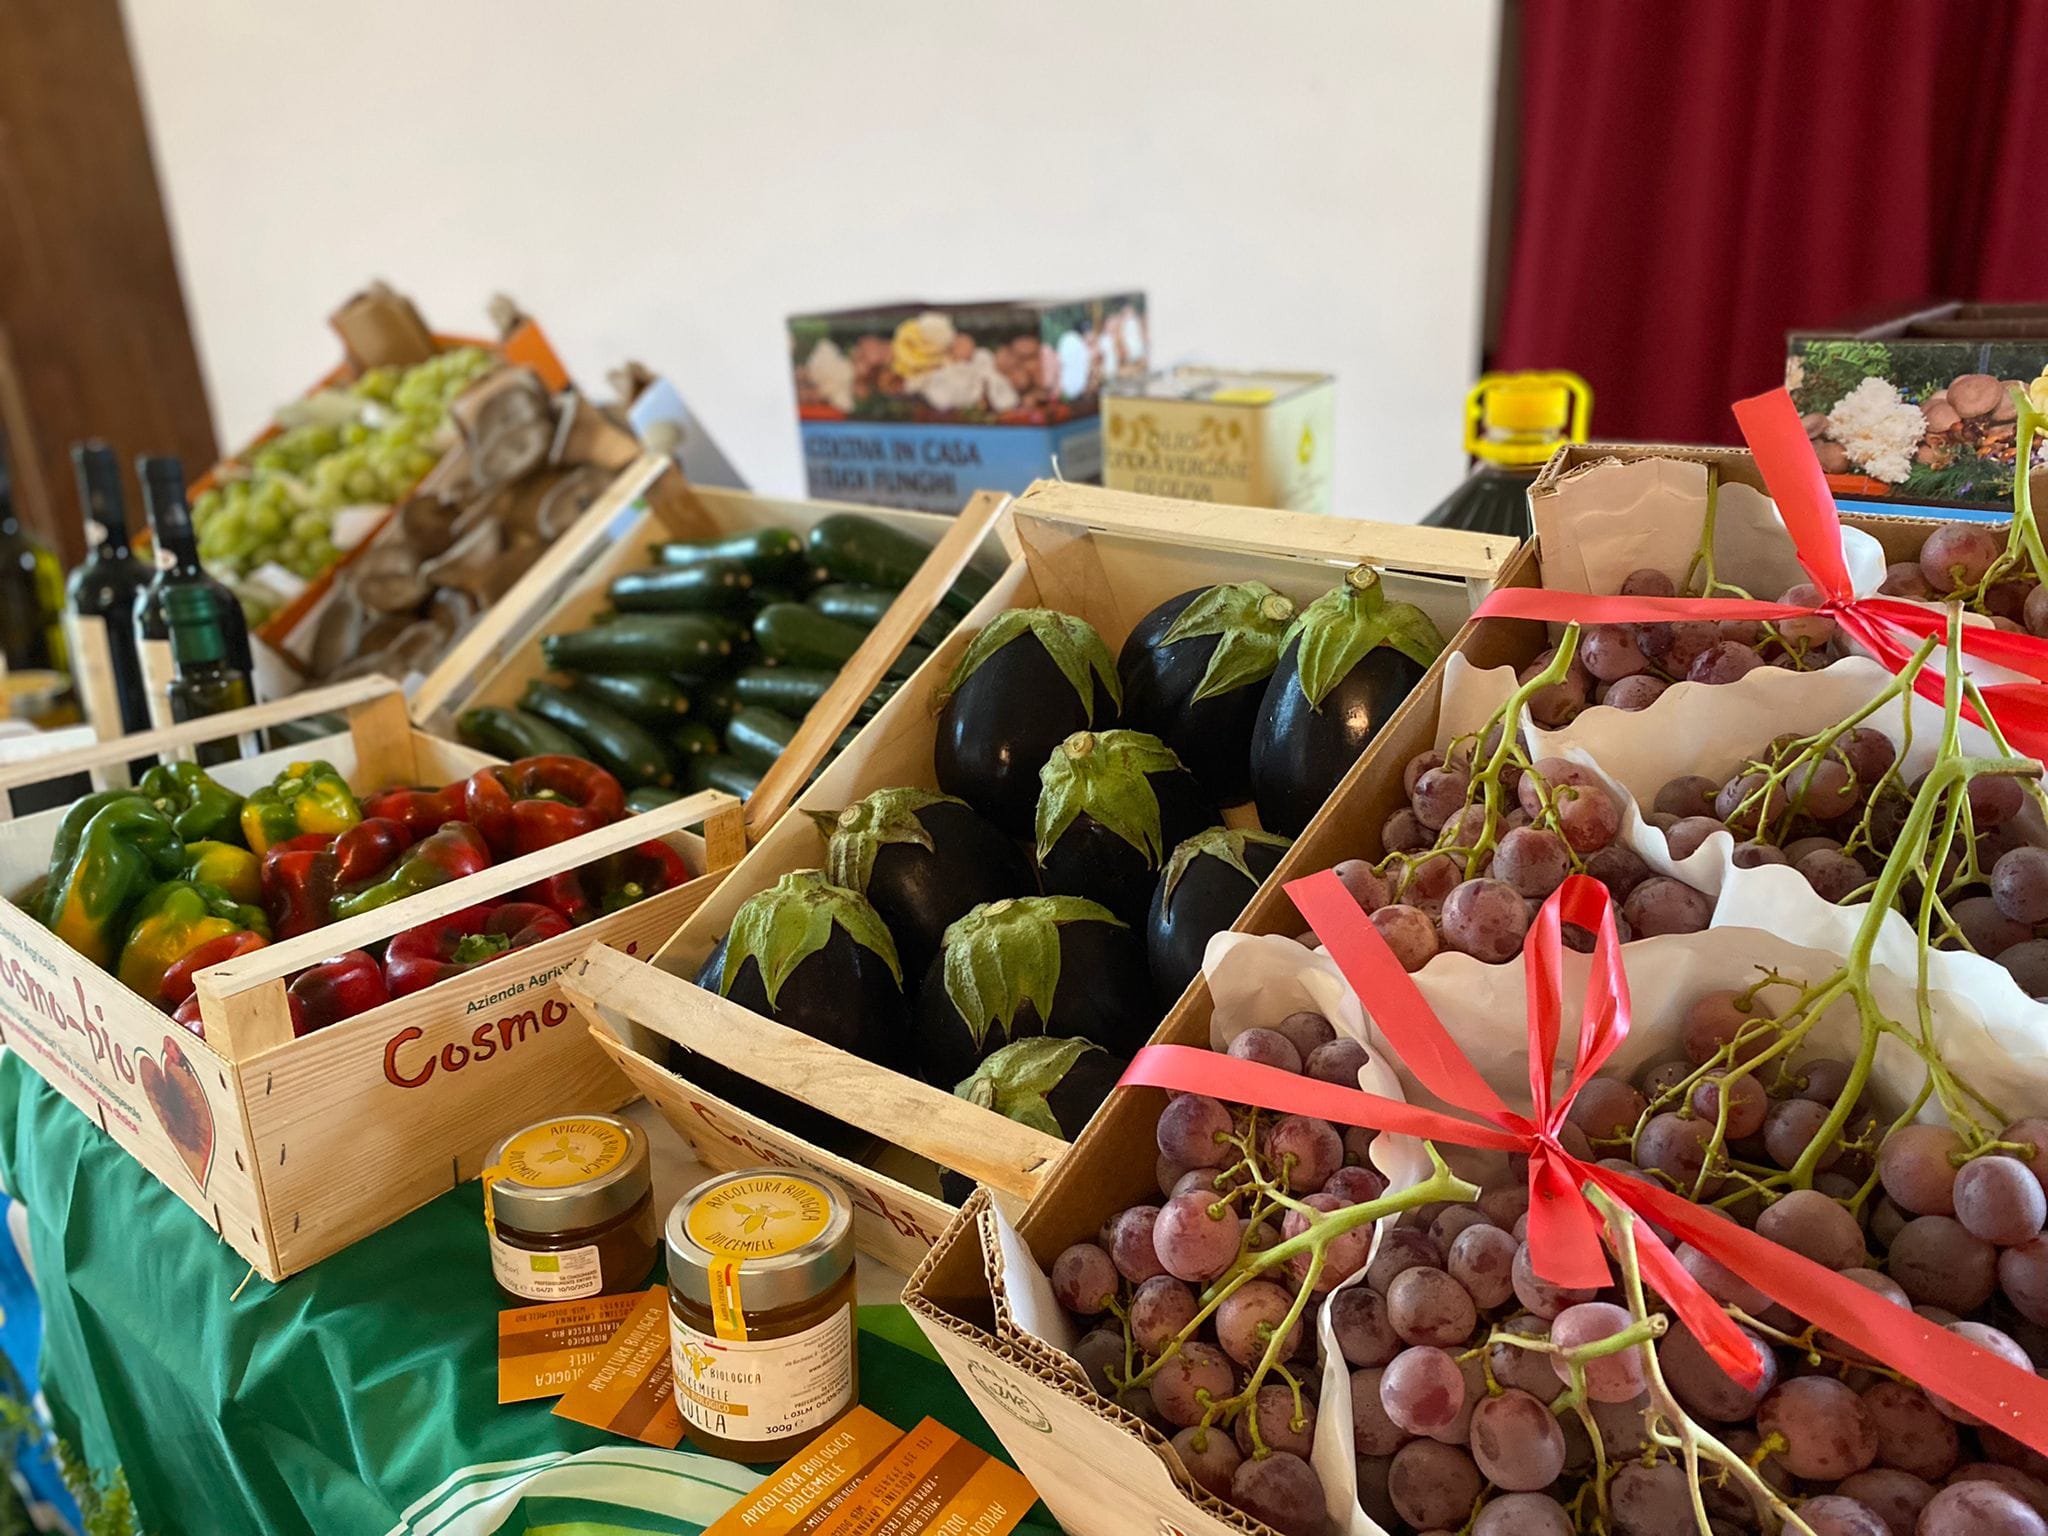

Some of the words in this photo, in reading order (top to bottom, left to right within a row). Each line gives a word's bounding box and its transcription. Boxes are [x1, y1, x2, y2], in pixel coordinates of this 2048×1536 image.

[891, 438, 916, 463] IN
[921, 437, 982, 467] CASA
[466, 983, 525, 1015] Azienda
[528, 958, 577, 988] Agric
[0, 953, 136, 1085] osmo-bio
[384, 998, 577, 1089] Cosmo
[550, 1123, 615, 1142] APICOLTURA
[507, 1149, 543, 1182] DOLCEMIELE
[705, 1181, 782, 1210] APICOLTURA
[782, 1184, 821, 1222] BIOLOGICA
[704, 1231, 776, 1252] DOLCEMIELE
[558, 1281, 594, 1293] 10/10/2023
[588, 1345, 634, 1393] APICOLTURA
[623, 1307, 664, 1348] BIOLOGICA
[622, 1333, 666, 1378] DOLCEMIELE
[709, 1368, 761, 1385] BIOLOGICA
[680, 1392, 727, 1434] SULLA
[765, 1423, 793, 1436] 300g
[903, 1453, 918, 1468] 339
[741, 1471, 807, 1527] APICOLTURA
[800, 1431, 856, 1476] BIOLOGICA
[783, 1462, 846, 1515] DOLCEMIELE
[880, 1471, 917, 1507] AGOSTINO
[913, 1479, 938, 1501] PAPPA
[806, 1505, 832, 1528] MIELE
[851, 1506, 885, 1536] LAMANN
[895, 1498, 919, 1519] REALE
[922, 1498, 942, 1521] MIELE
[968, 1501, 1008, 1536] APICOL
[877, 1516, 902, 1536] FRESC
